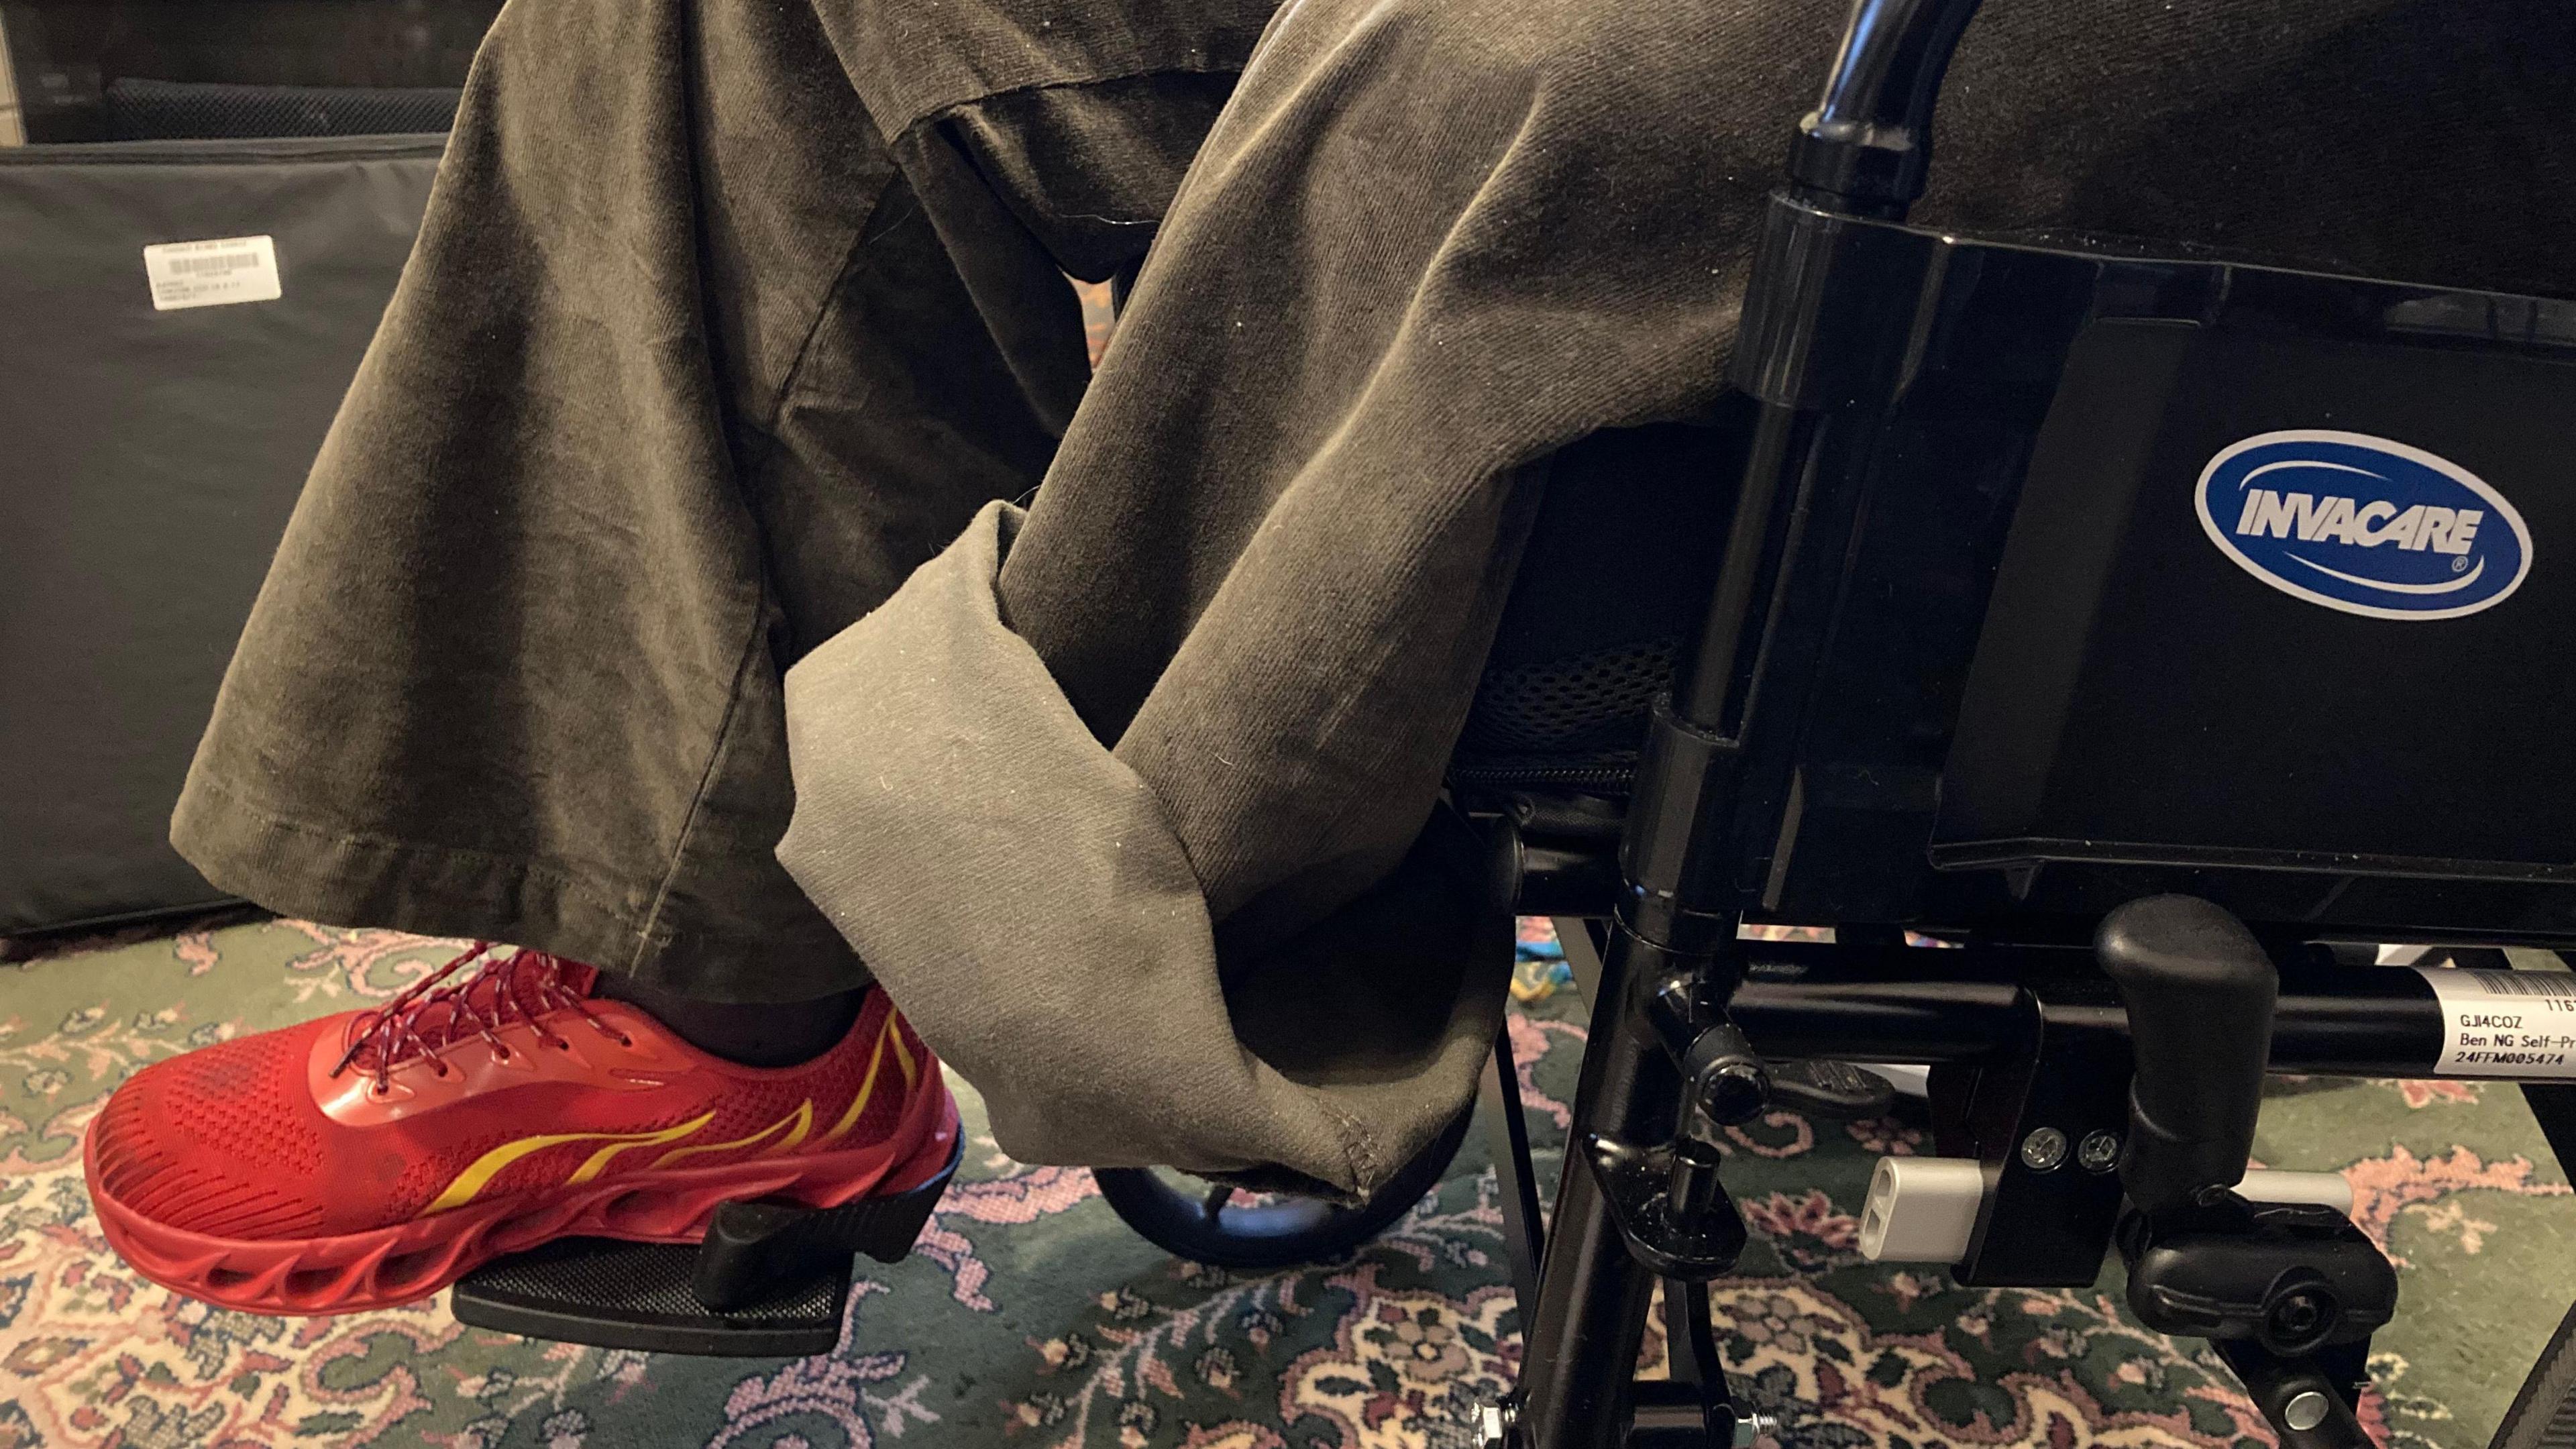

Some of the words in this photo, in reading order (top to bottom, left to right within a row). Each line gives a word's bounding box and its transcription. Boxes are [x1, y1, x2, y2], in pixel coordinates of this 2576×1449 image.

[2235, 488, 2484, 555] INVACARE
[2545, 999, 2576, 1012] 116
[2460, 1033, 2487, 1046] Ben
[2493, 1034, 2514, 1047] NG
